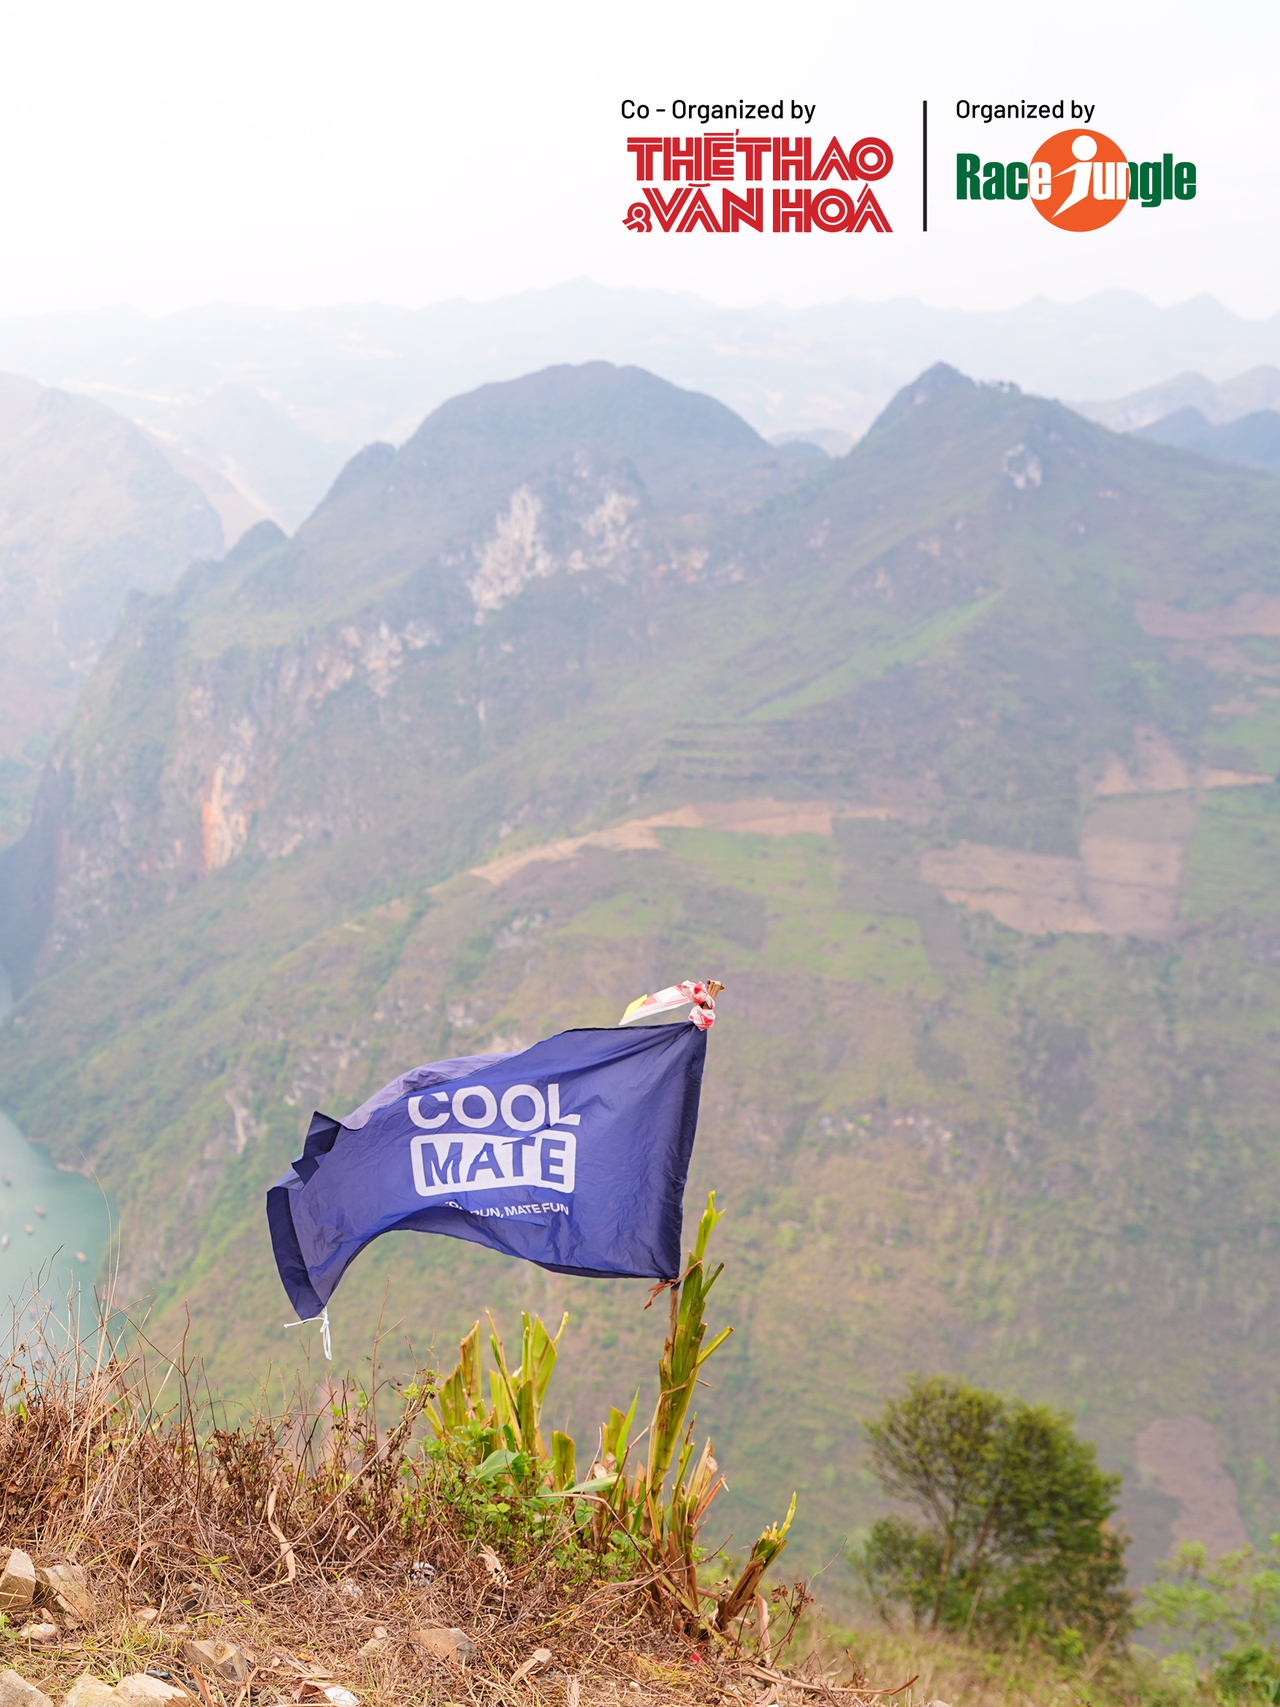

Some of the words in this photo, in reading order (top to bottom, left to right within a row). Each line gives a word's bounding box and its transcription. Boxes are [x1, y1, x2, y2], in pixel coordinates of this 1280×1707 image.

[408, 1083, 581, 1131] COOL
[421, 1137, 567, 1187] MATE
[504, 1204, 542, 1216] MATE
[542, 1202, 569, 1216] FUN
